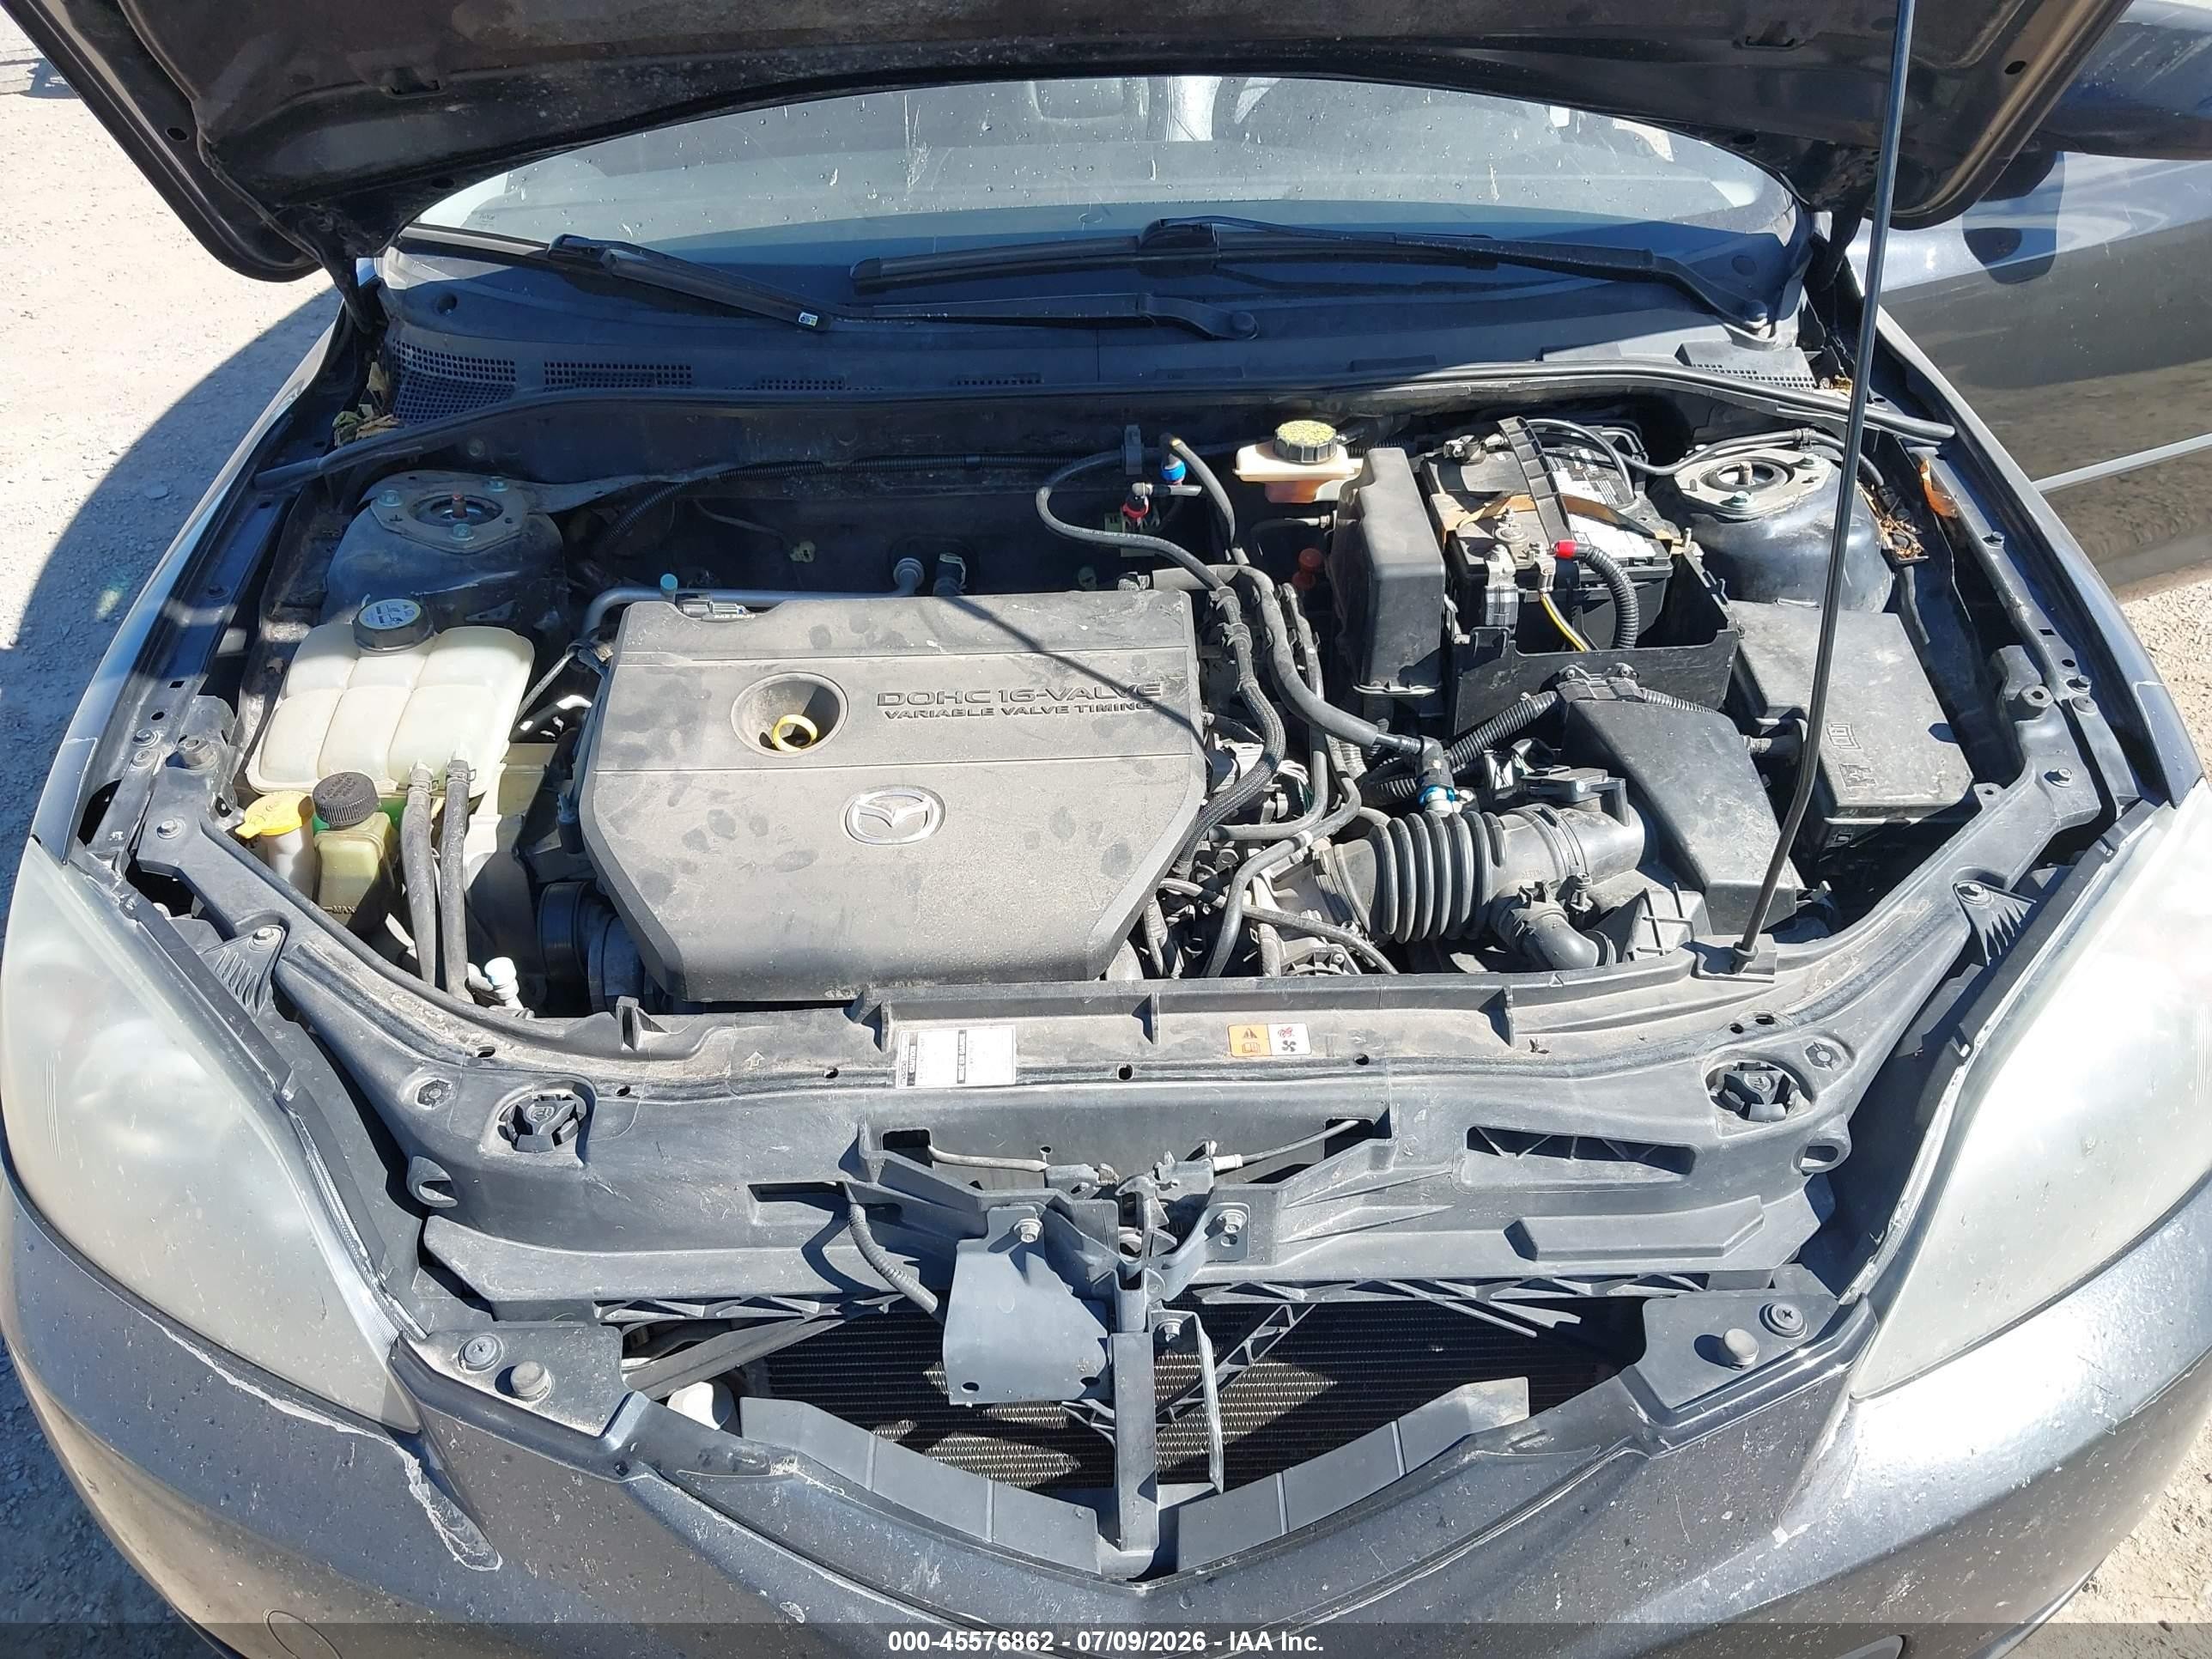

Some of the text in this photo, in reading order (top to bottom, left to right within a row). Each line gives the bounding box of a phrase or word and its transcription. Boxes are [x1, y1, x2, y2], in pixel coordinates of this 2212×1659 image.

[877, 681, 1163, 707] DOHC 16-VALVE
[884, 702, 1155, 720] VARIABLE VALVE TIMING
[332, 905, 357, 914] MAX
